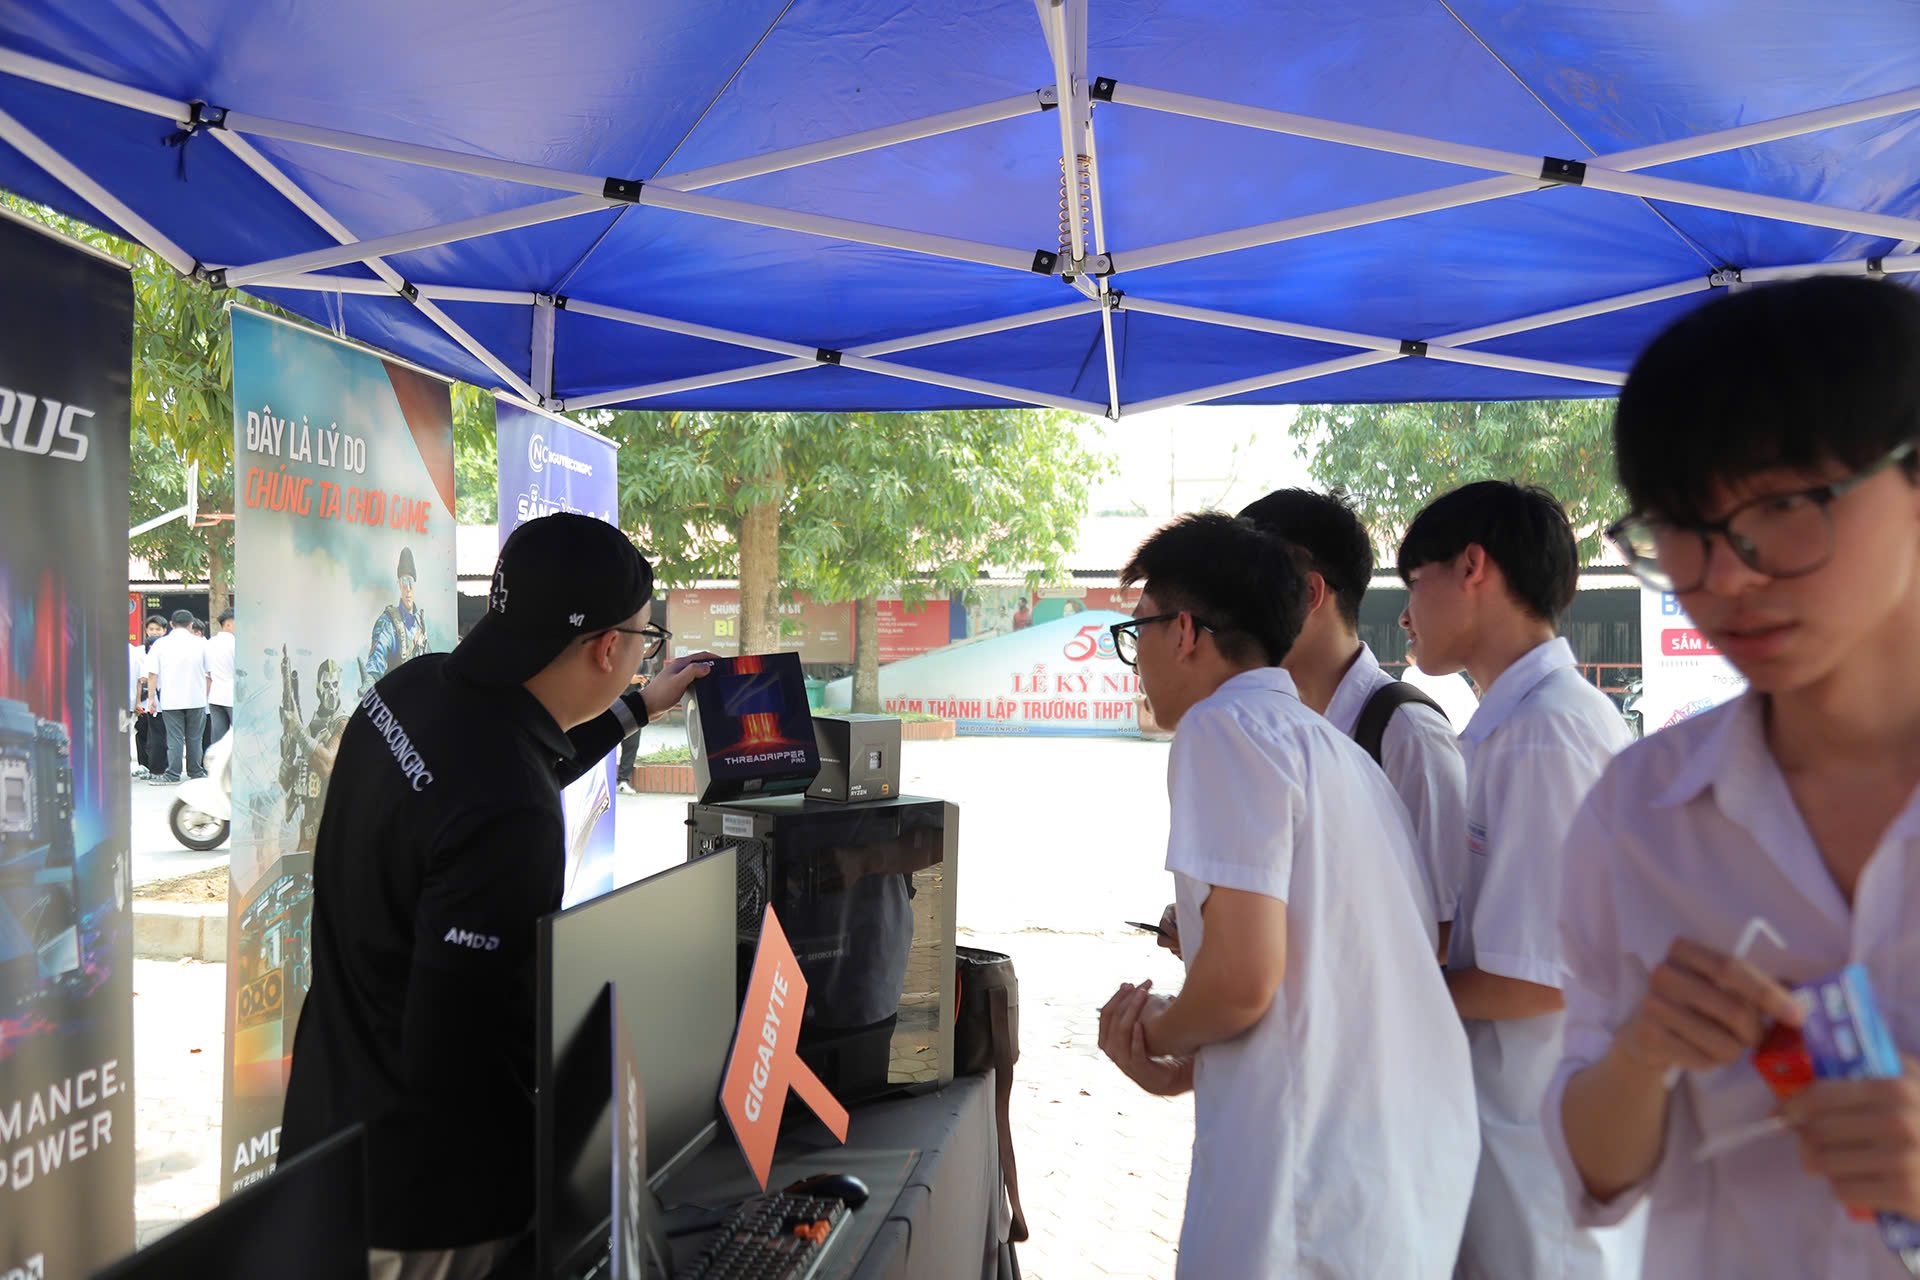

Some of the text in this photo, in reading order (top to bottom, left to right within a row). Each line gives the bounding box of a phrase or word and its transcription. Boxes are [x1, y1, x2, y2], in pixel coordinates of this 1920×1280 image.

[246, 404, 367, 474] ĐÂY LÀ LÝ DO
[245, 463, 432, 535] CHÚNG TA CHƠI GAME
[1671, 632, 1701, 650] SẮM
[1012, 664, 1049, 693] LỄ
[1056, 666, 1095, 693] KỶ
[886, 696, 1134, 723] NĂM THÀNH LẬP TRƯỜNG THPT
[725, 750, 805, 765] THREADRIPPER
[444, 927, 486, 949] AMD
[744, 970, 789, 1122] GIGABYTE
